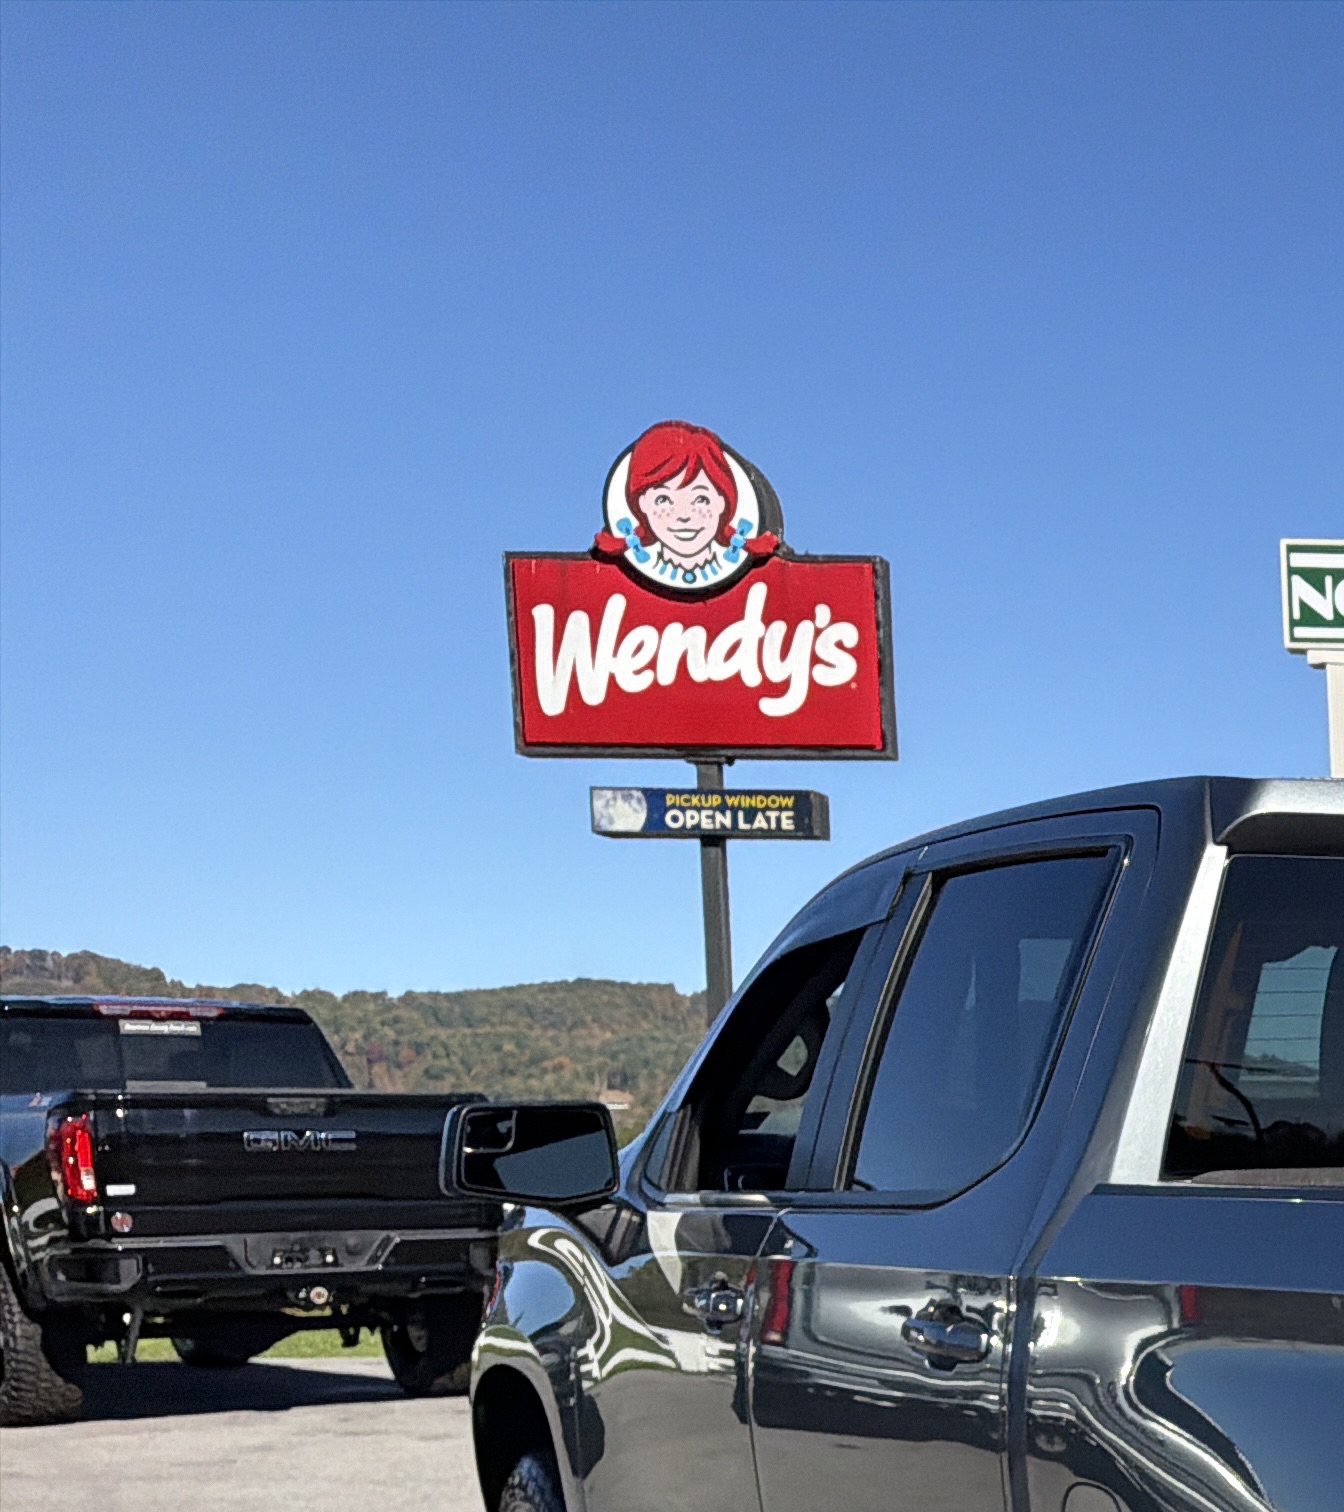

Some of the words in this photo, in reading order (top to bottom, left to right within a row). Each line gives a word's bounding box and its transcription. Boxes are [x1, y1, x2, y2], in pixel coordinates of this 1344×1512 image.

[532, 582, 859, 717] Wendy's
[665, 793, 722, 808] PICKUP
[726, 794, 795, 809] WINDOW
[664, 809, 732, 829] OPEN
[737, 810, 796, 831] LATE
[243, 1130, 357, 1151] GMC
